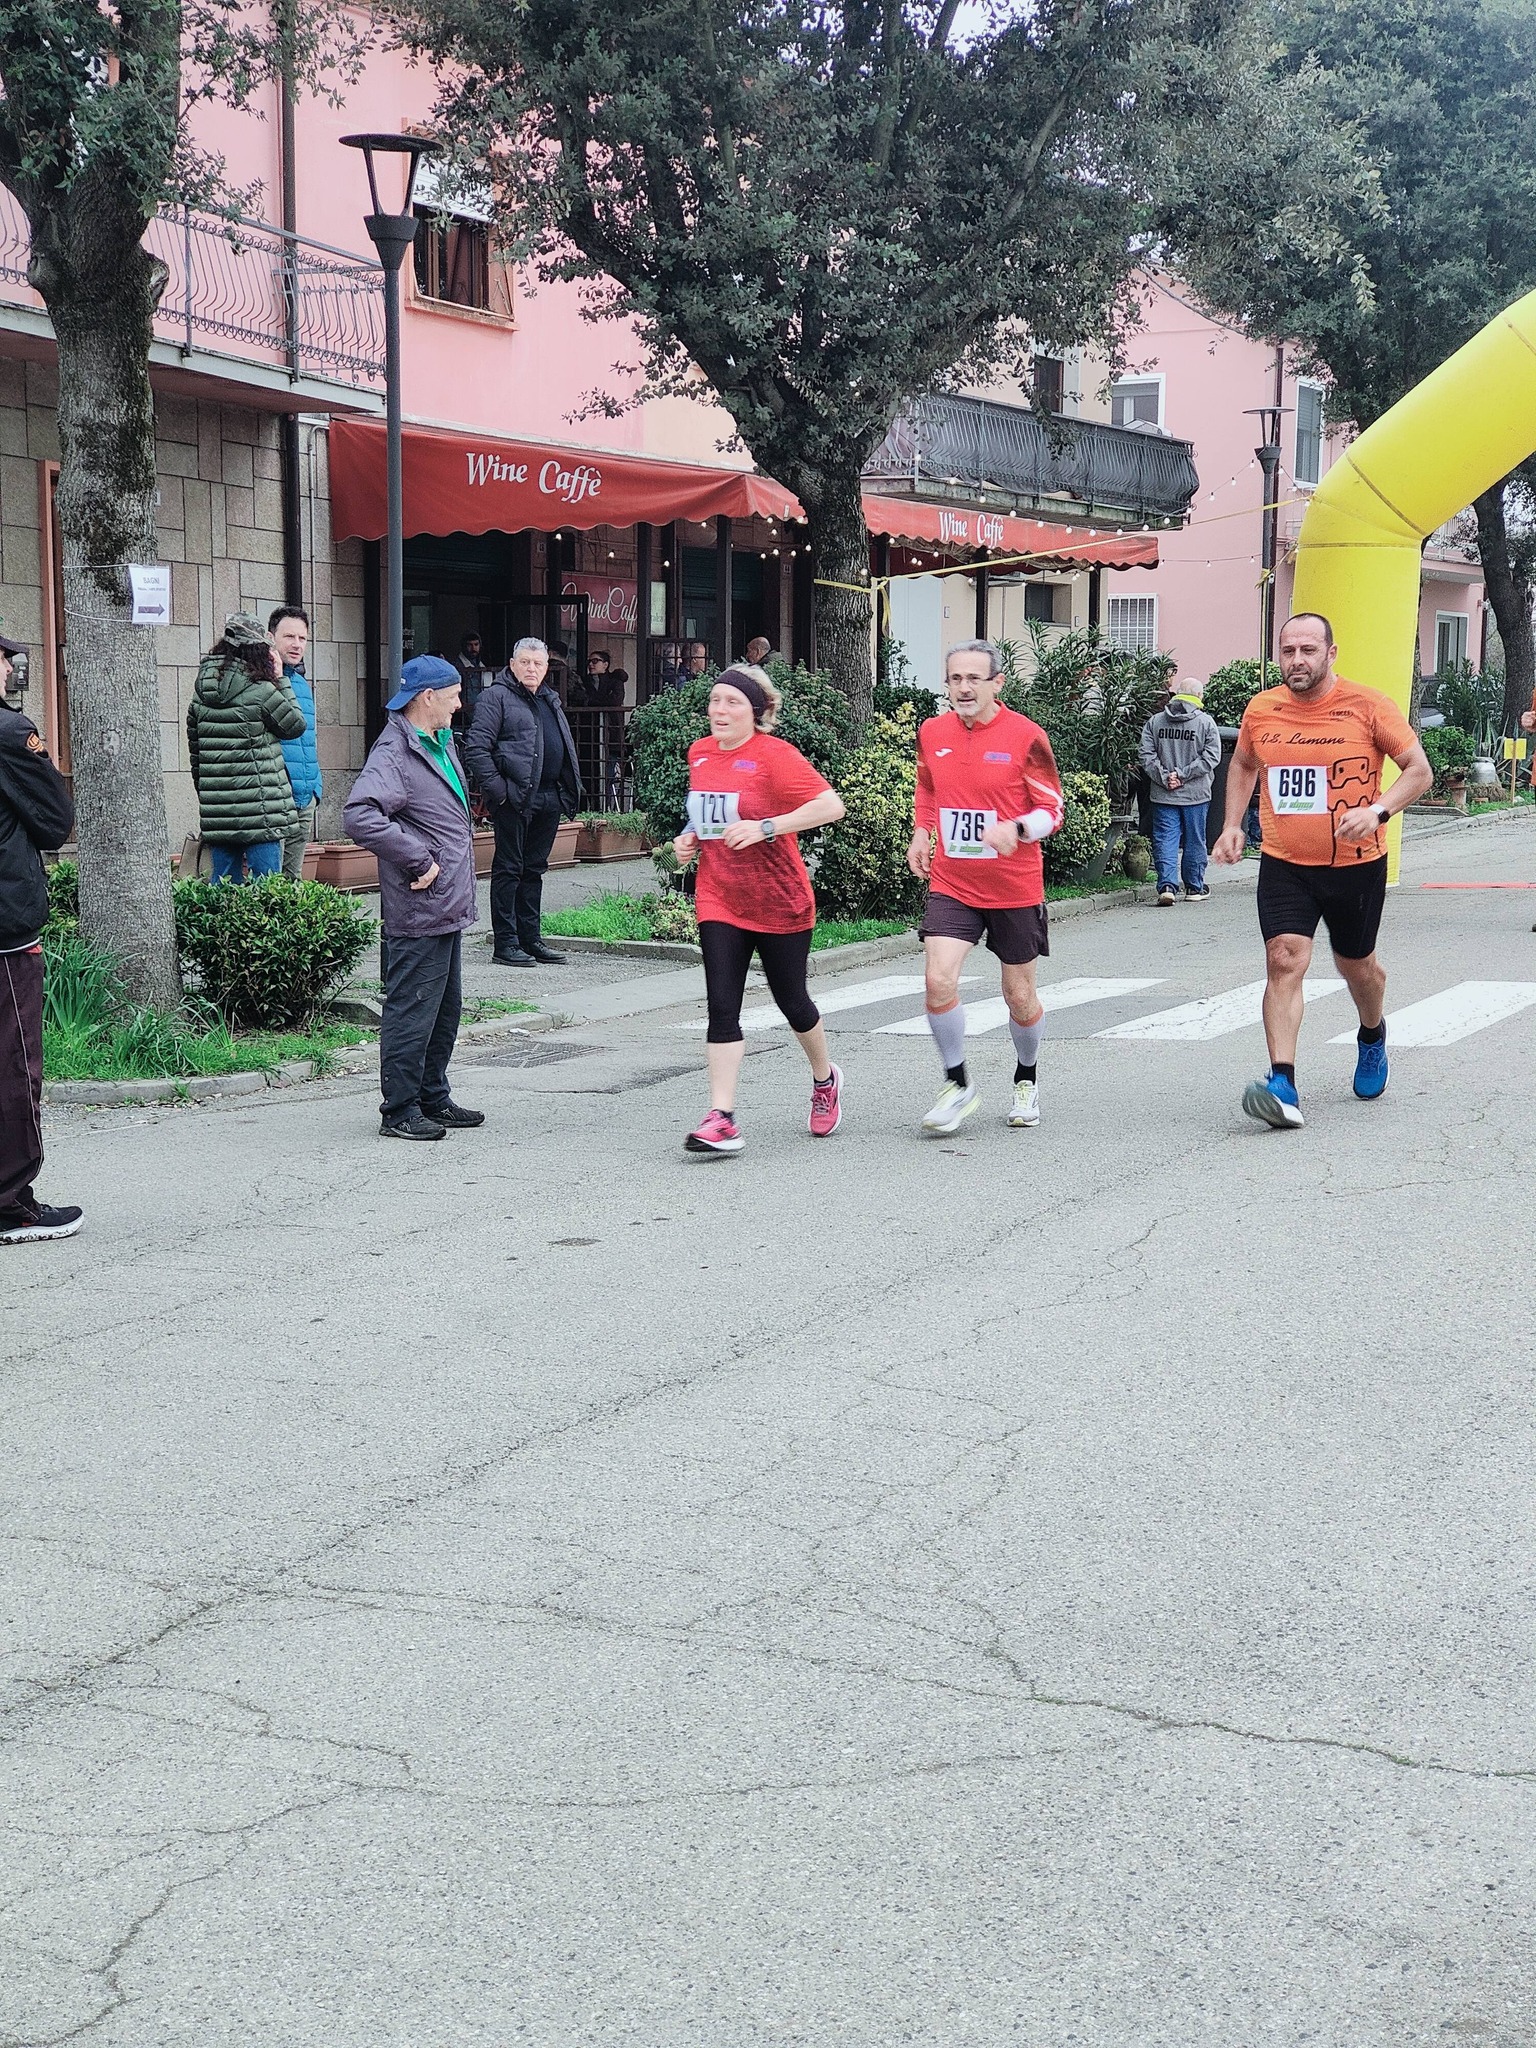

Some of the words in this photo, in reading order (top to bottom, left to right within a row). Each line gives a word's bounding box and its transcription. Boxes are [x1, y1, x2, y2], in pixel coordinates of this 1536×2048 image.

[466, 452, 528, 486] Wine
[538, 460, 602, 503] Caffè
[939, 511, 968, 541] Wine
[977, 514, 1004, 549] Caffè
[1159, 728, 1196, 741] GIUDICE
[1286, 732, 1345, 745] Lamone
[1279, 768, 1316, 797] 696
[700, 793, 727, 823] 727
[951, 811, 985, 842] 736
